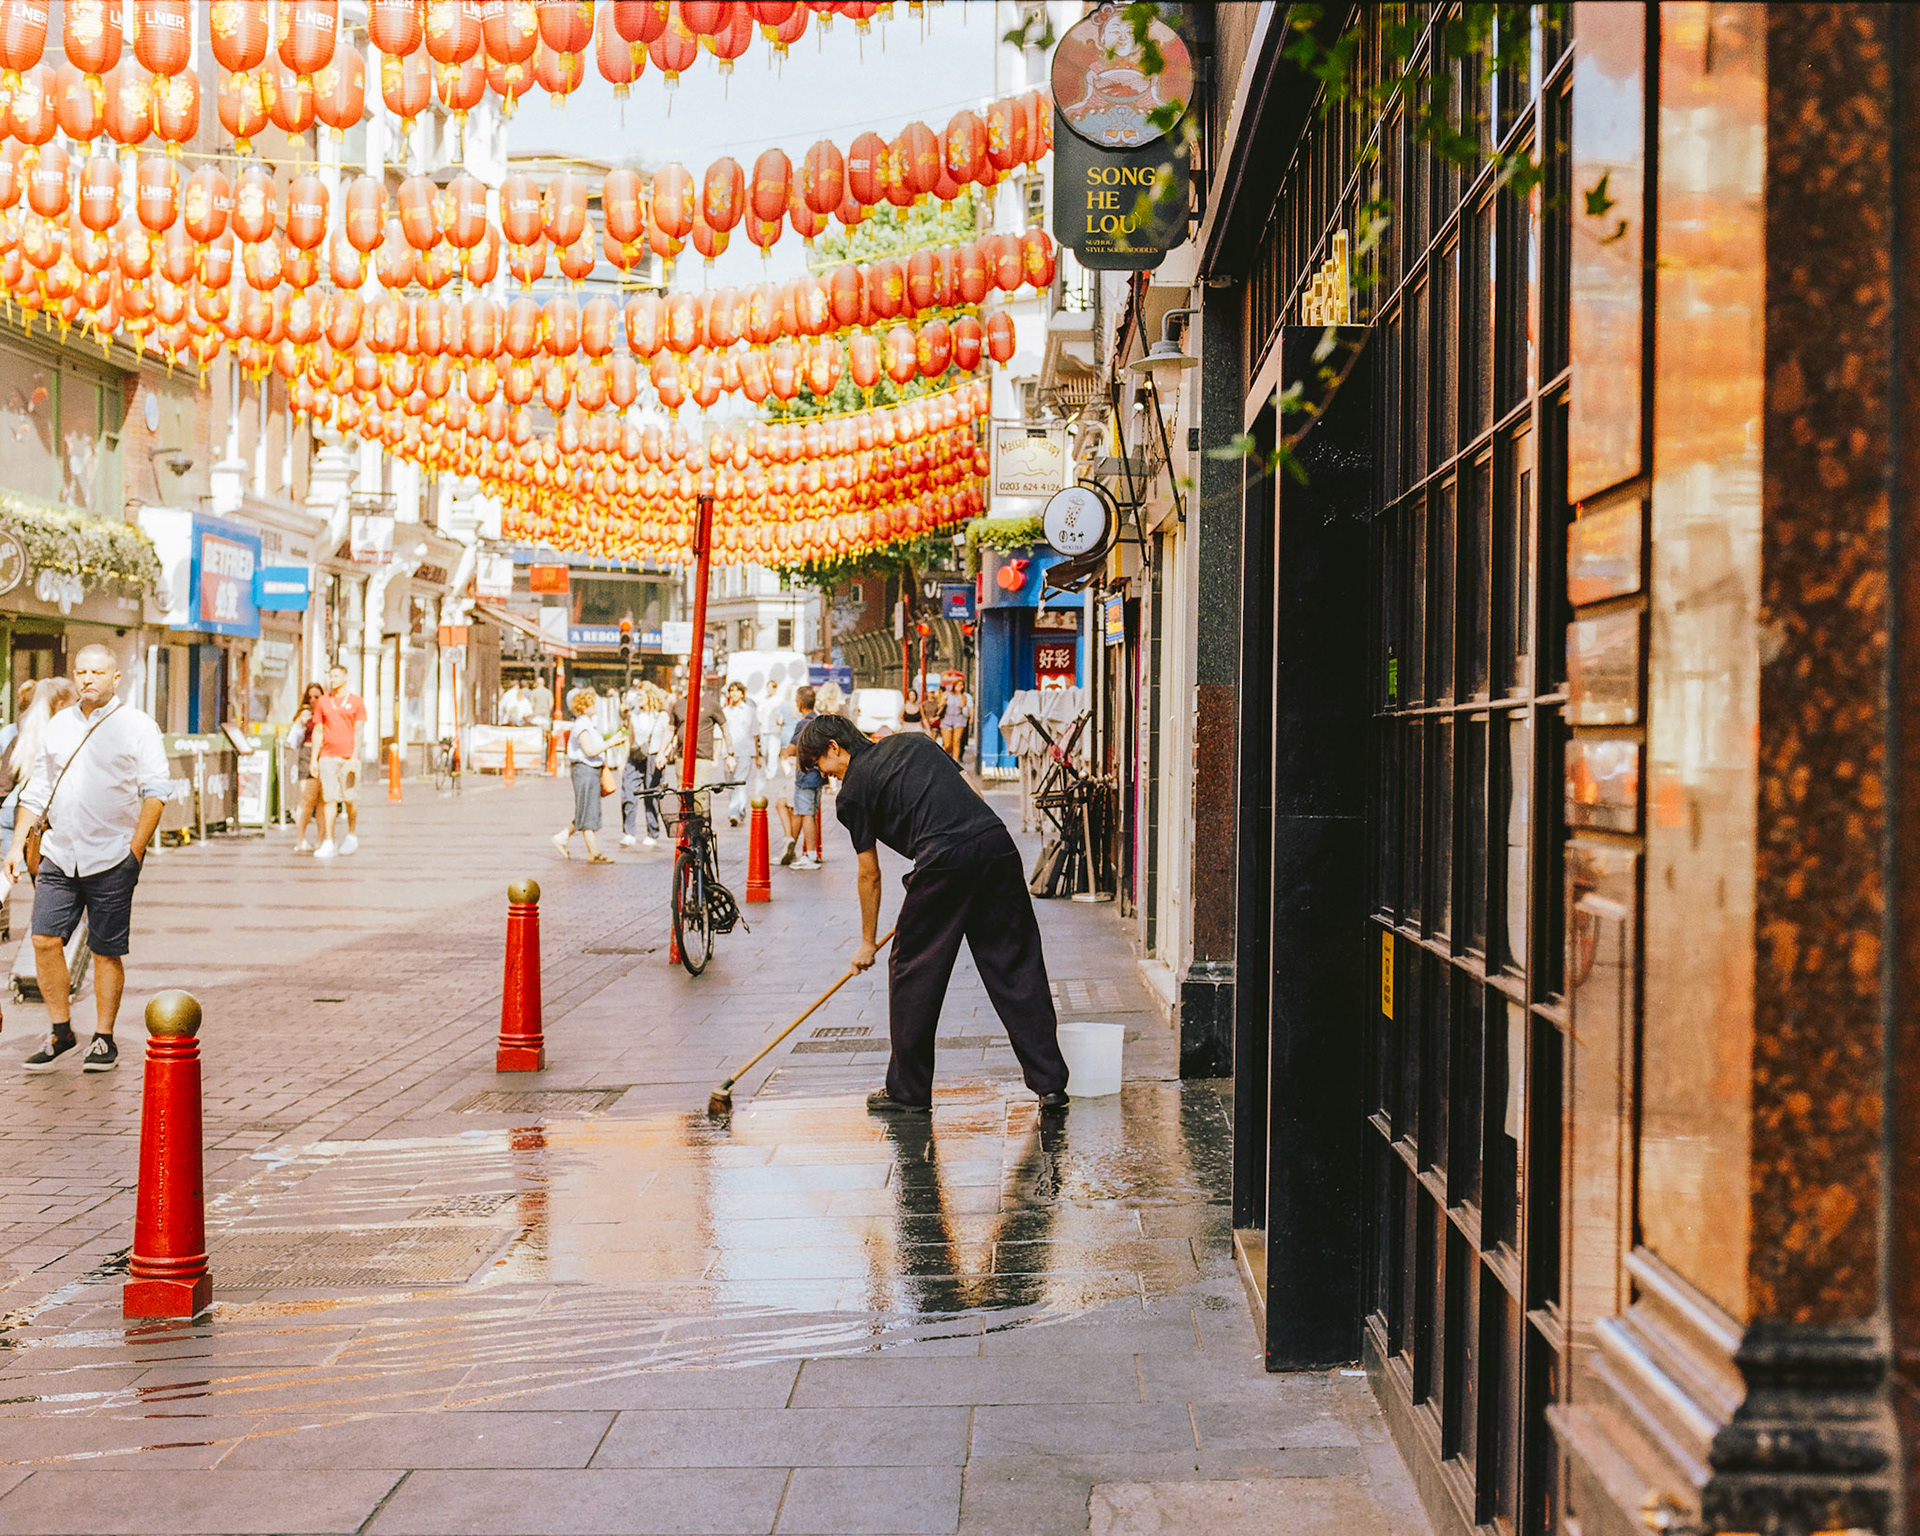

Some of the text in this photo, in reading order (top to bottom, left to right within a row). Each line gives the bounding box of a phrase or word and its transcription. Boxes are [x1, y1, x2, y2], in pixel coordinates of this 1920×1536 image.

[12, 4, 47, 24] LNER
[145, 10, 186, 29] LNER
[295, 9, 334, 28] LNER
[32, 170, 64, 182] LNER
[1087, 167, 1156, 186] SONG
[83, 185, 115, 197] LNER
[140, 185, 172, 198] LNER
[1087, 191, 1120, 209] HE
[291, 204, 323, 216] LNER
[1086, 215, 1137, 234] LOU
[1000, 482, 1061, 491] 0203 624 4126
[1039, 649, 1070, 669] 好彩
